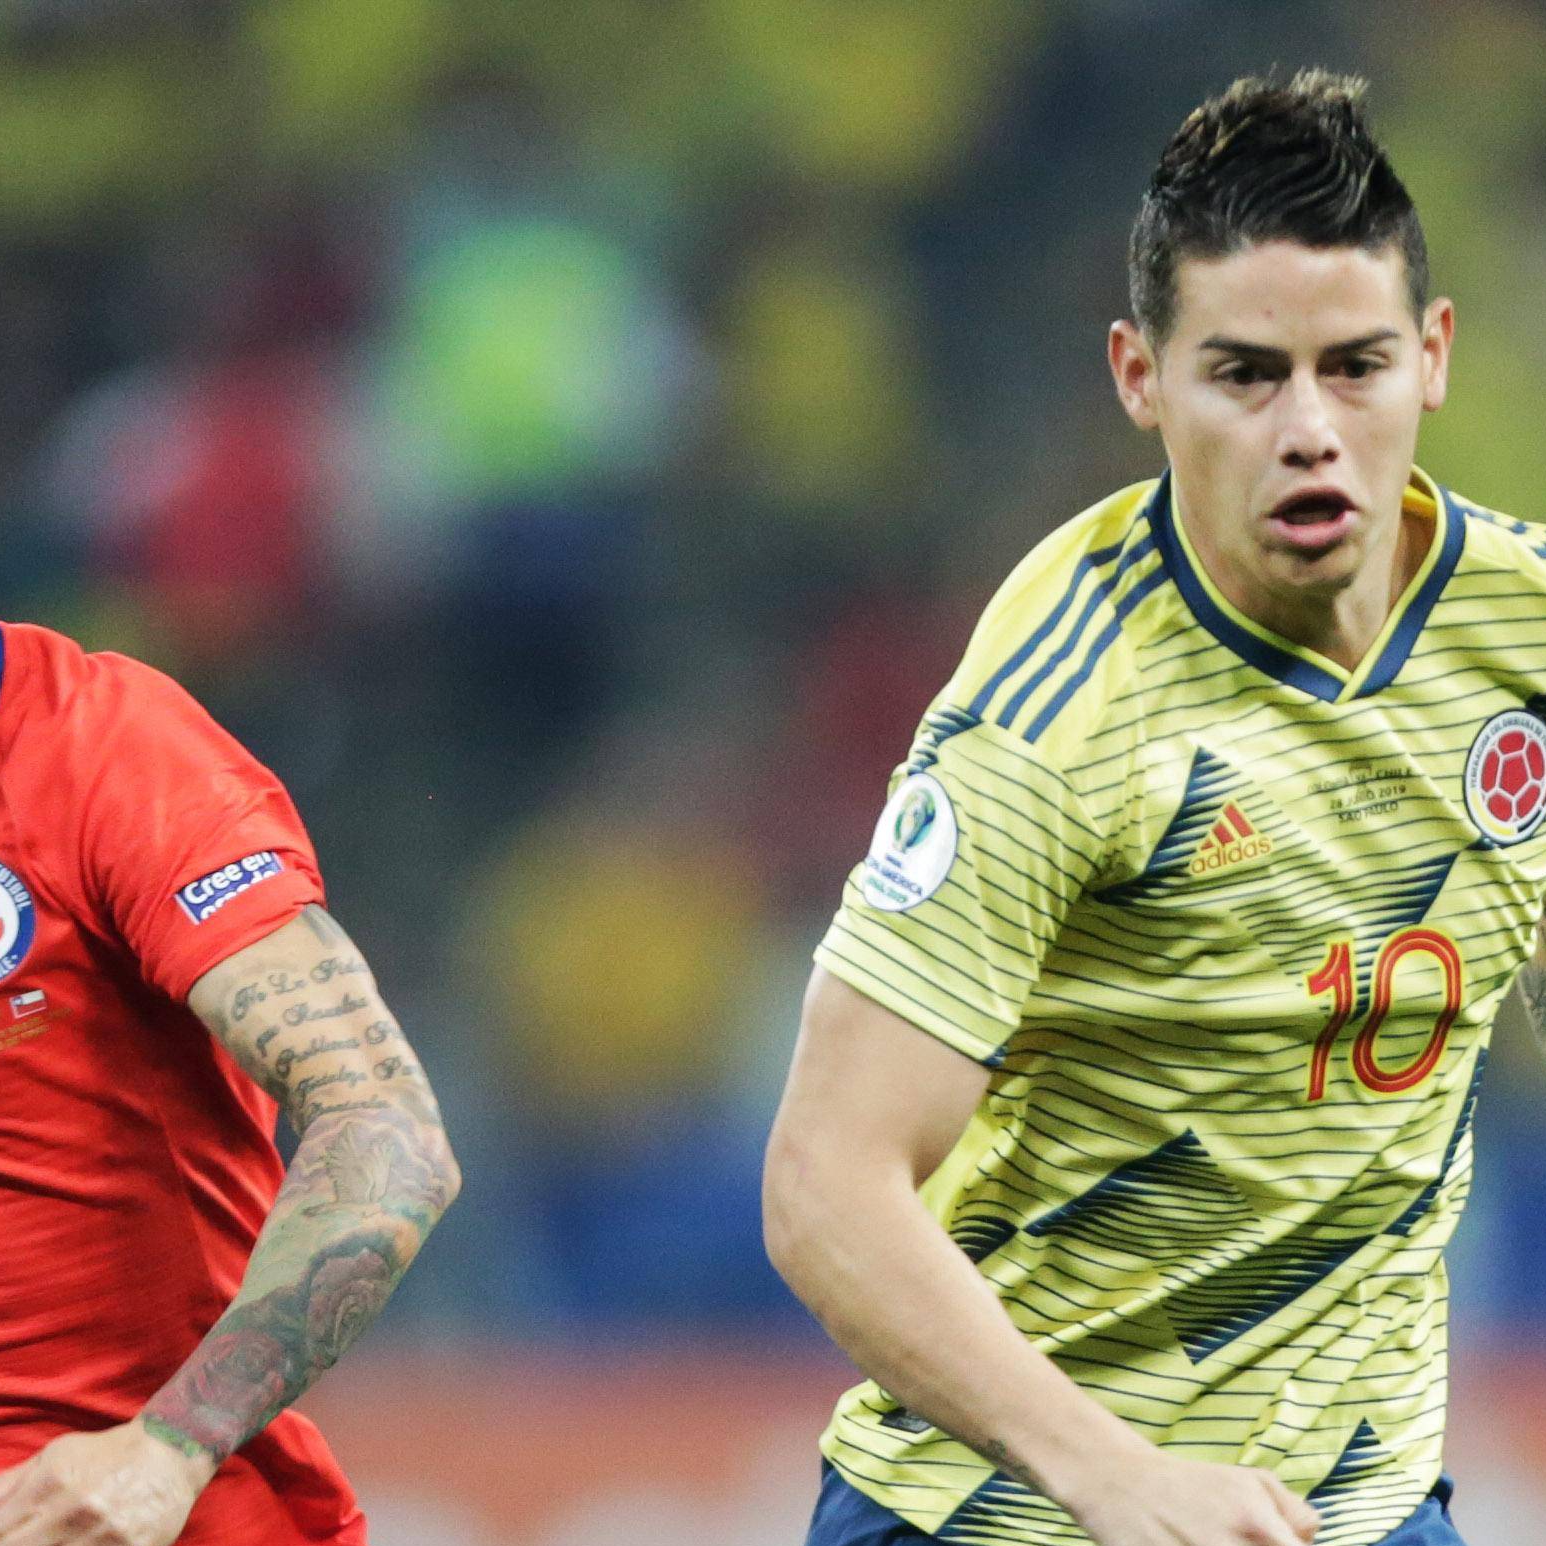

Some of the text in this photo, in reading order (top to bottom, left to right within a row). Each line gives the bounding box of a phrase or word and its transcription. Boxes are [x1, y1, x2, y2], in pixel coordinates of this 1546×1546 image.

[1375, 767, 1411, 779] CHILE
[1191, 834, 1272, 876] adidas
[184, 863, 244, 905] Cree
[1305, 927, 1464, 1103] 10
